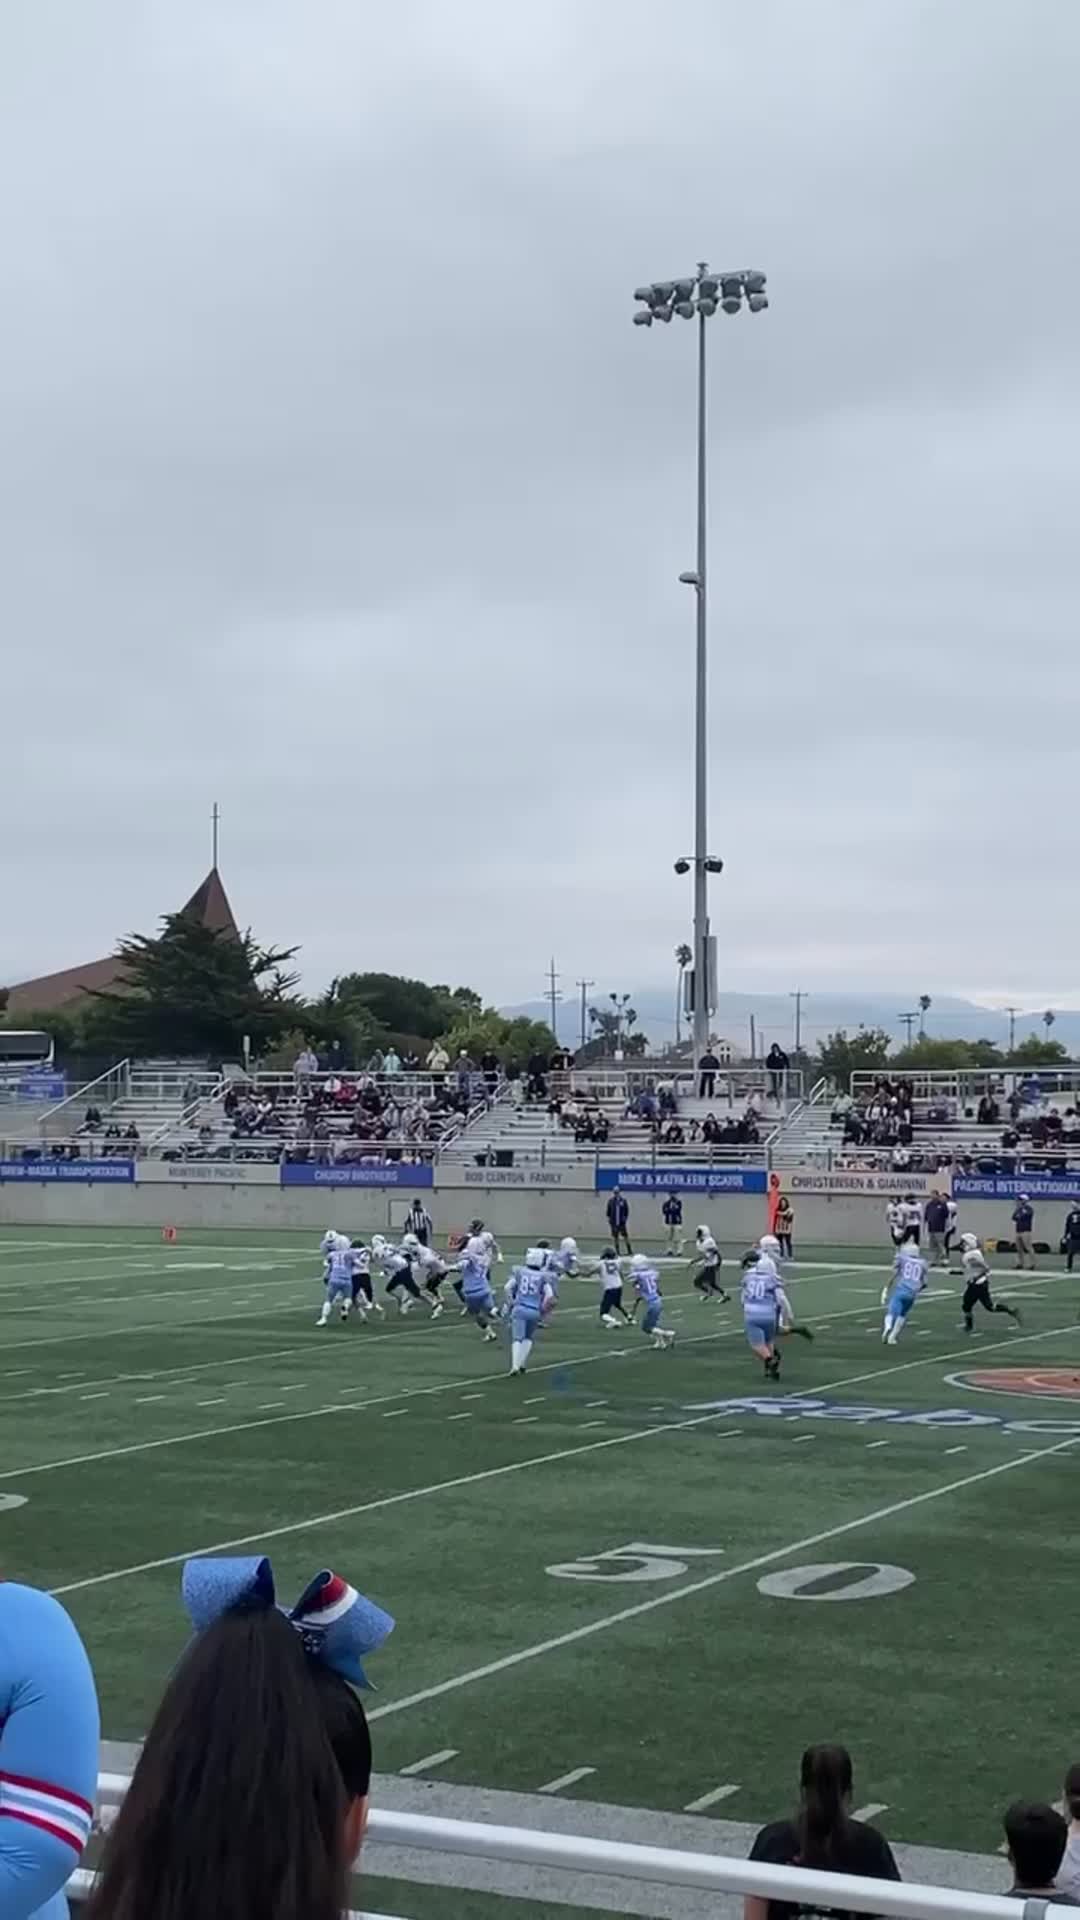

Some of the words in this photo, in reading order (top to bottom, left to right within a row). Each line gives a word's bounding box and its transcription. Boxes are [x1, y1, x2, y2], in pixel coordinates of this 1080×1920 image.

[352, 1170, 398, 1182] BROTHERS
[529, 1172, 563, 1184] FAMILY
[791, 1176, 864, 1189] CHRISTENSEN
[866, 1177, 875, 1189] &
[877, 1178, 926, 1190] GIANNINI
[954, 1179, 994, 1192] PACIFIC
[903, 1261, 921, 1281] 80
[519, 1275, 540, 1295] 85
